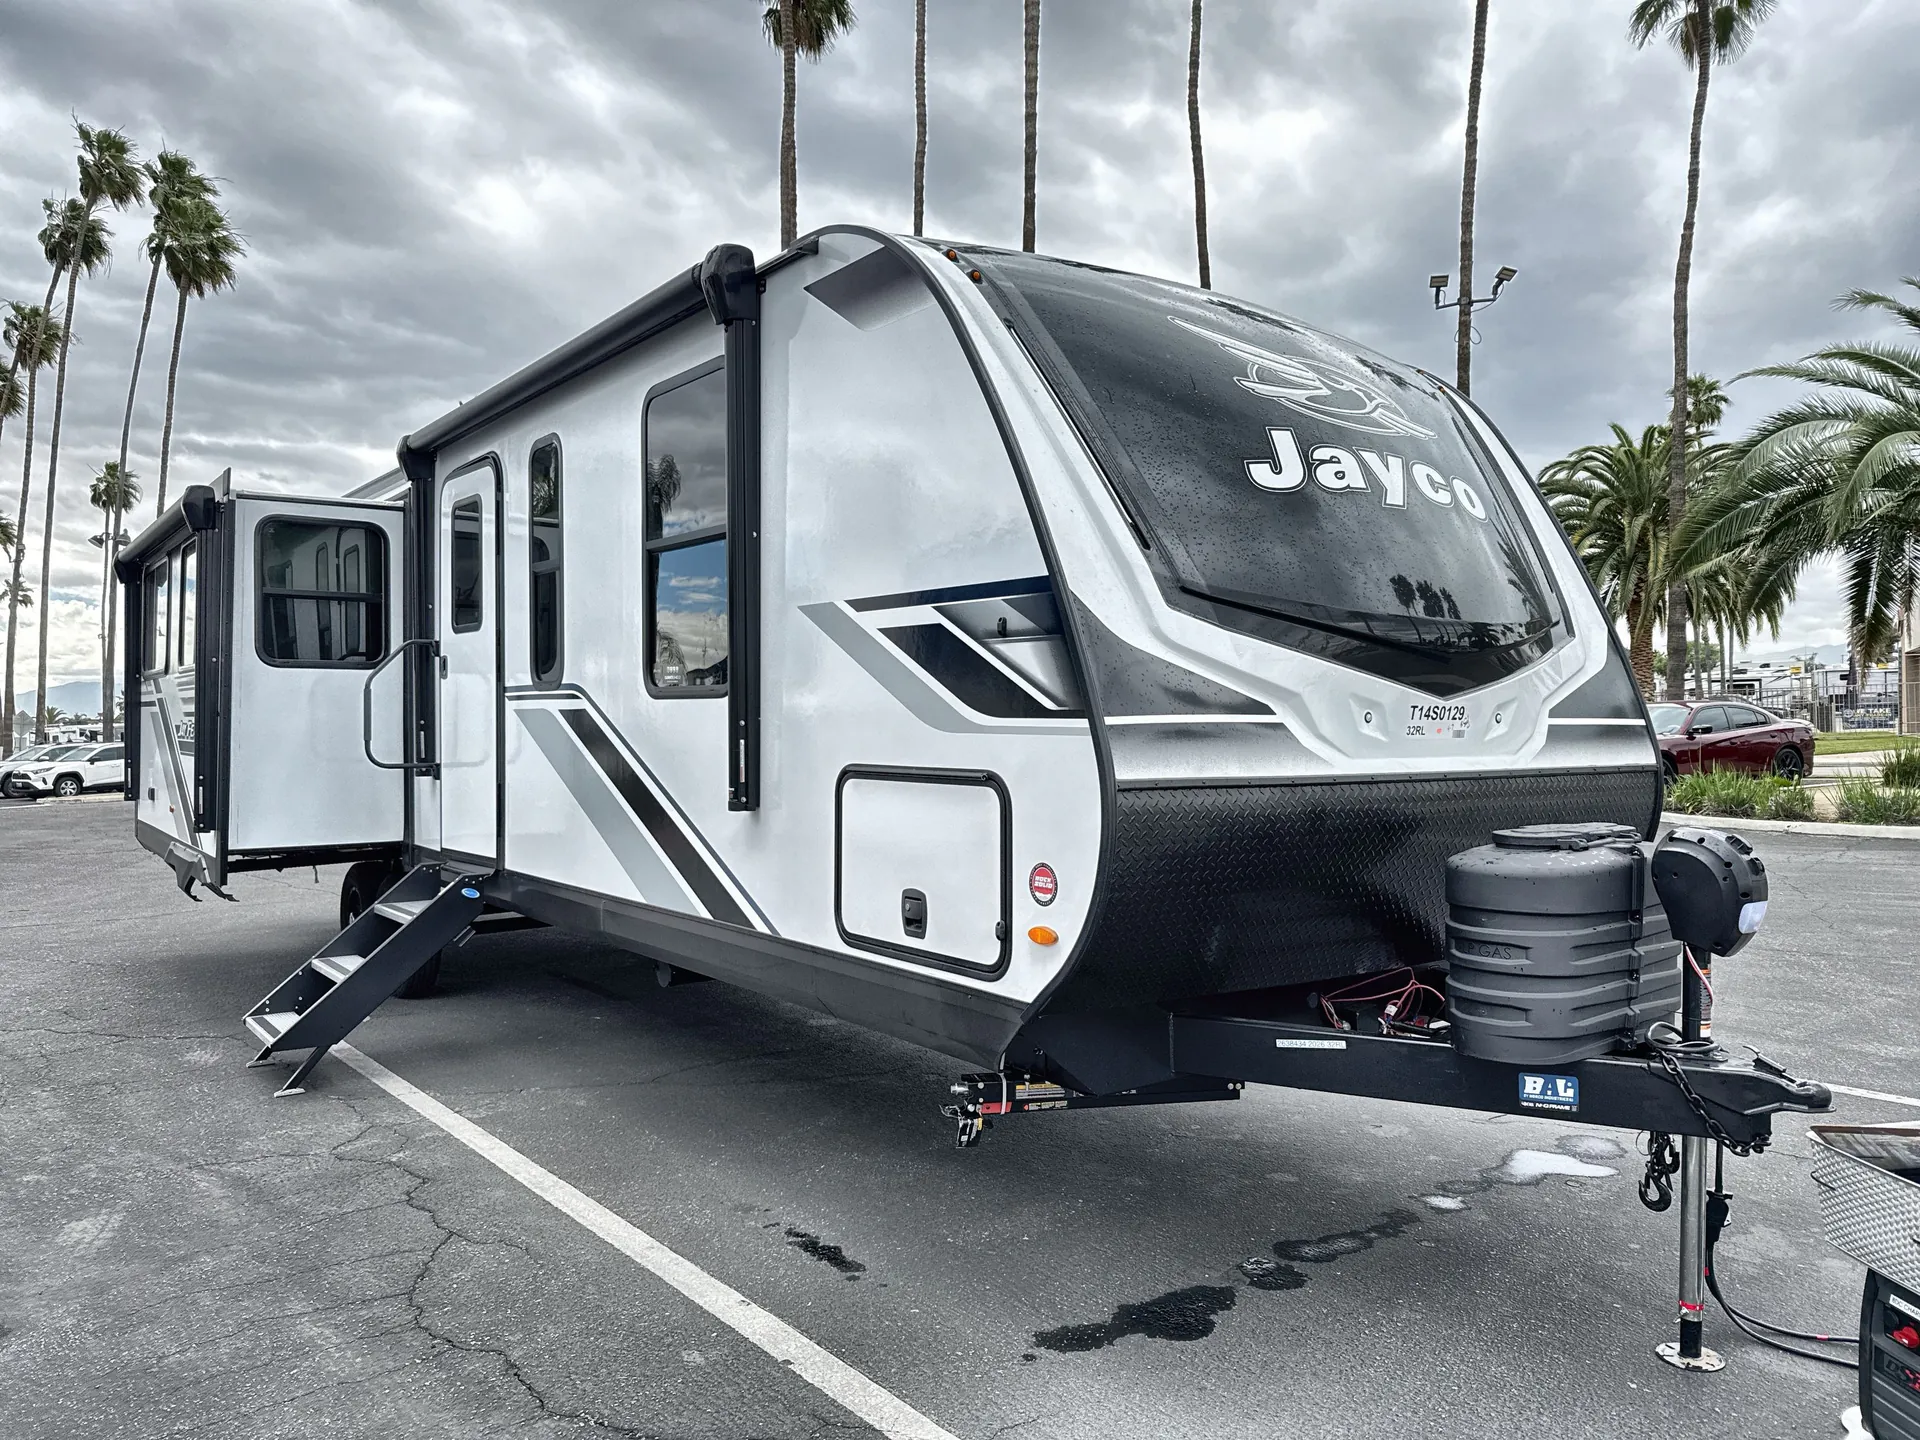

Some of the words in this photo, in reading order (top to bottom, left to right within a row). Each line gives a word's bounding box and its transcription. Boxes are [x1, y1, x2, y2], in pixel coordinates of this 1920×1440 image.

[1244, 426, 1488, 523] Jayco
[1410, 705, 1465, 721] T14S0129
[1406, 725, 1426, 736] 32RL
[1034, 875, 1052, 883] ROCK
[1034, 881, 1053, 889] SOLID
[1479, 944, 1512, 960] GAS
[1326, 1041, 1345, 1049] 32RL
[1523, 1075, 1575, 1098] BAL
